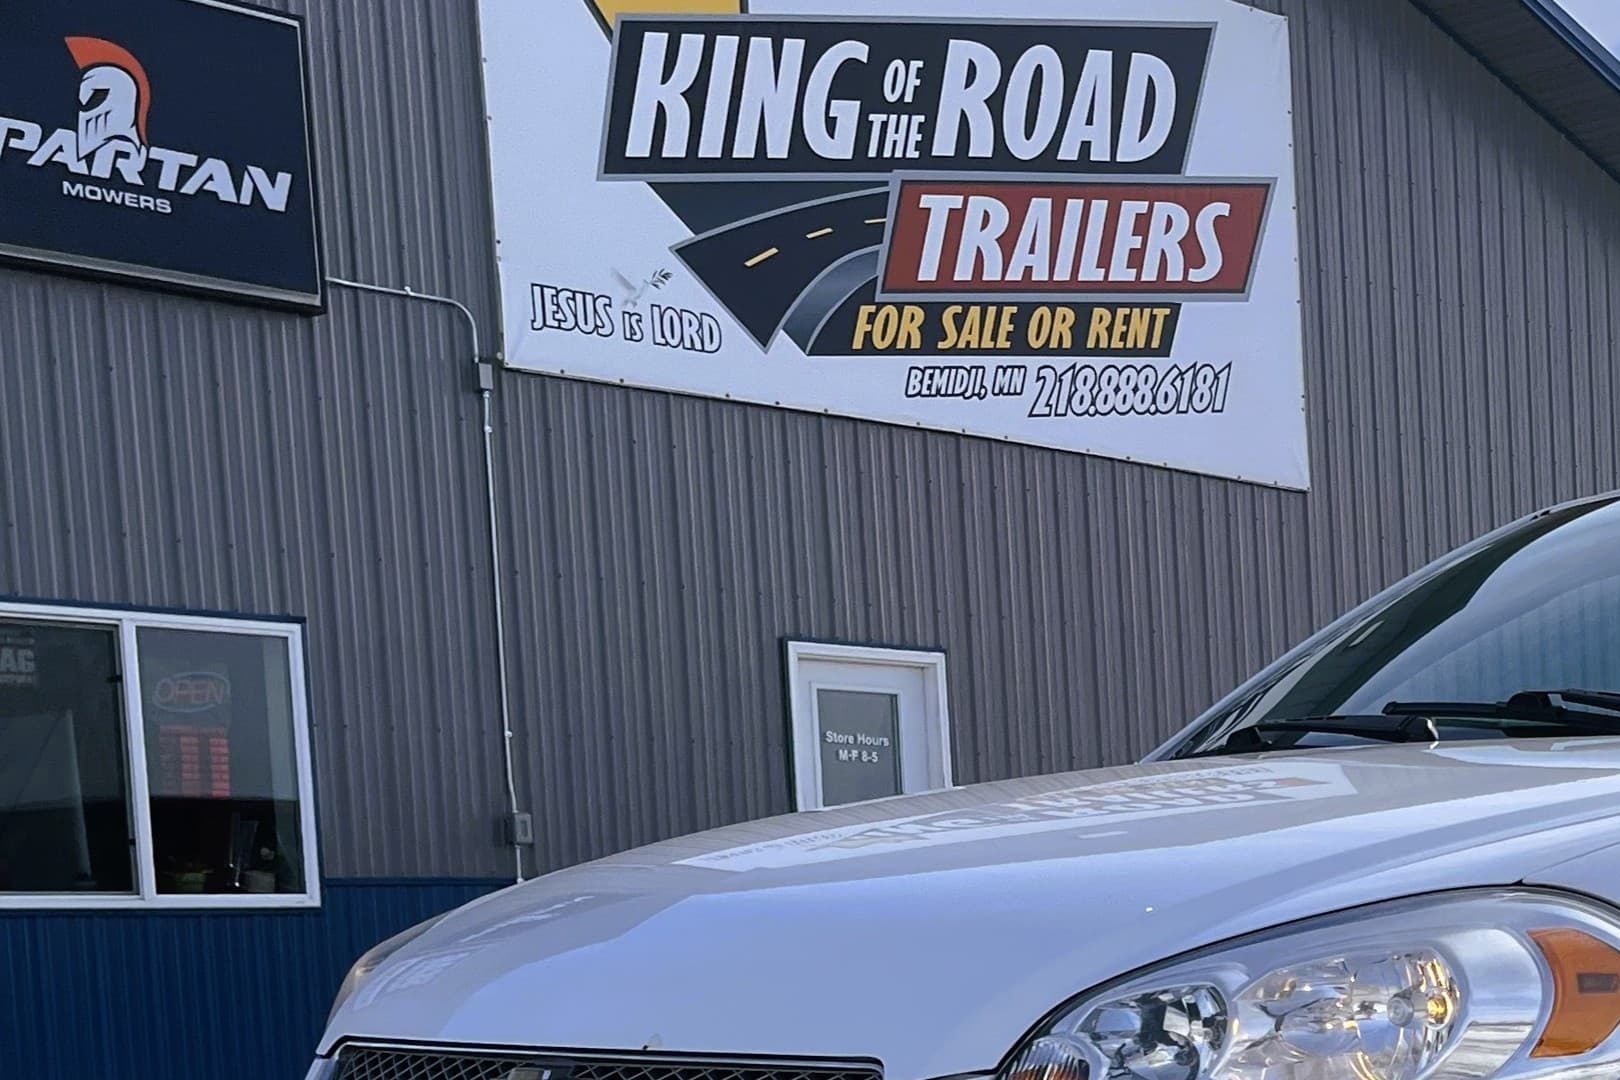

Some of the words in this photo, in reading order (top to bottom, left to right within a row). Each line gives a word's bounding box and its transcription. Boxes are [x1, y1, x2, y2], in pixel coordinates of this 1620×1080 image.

[625, 31, 869, 160] KING
[883, 59, 923, 102] OF
[931, 39, 1176, 162] ROAD
[868, 114, 925, 158] THE
[0, 116, 292, 212] PARTAN
[62, 181, 172, 213] MOWERS
[917, 194, 1230, 282] TRAILERS
[531, 283, 614, 337] JESUS
[651, 304, 722, 353] LORD
[851, 305, 925, 349] FOR
[937, 305, 1018, 349] SALE
[1027, 306, 1075, 349] OR
[1086, 307, 1171, 349] RENT
[905, 366, 987, 399] BEMIDJI,
[992, 366, 1027, 395] MN
[1028, 361, 1232, 418] 218.888.6181
[155, 678, 225, 704] OPEN
[826, 730, 854, 744] Store
[857, 733, 889, 746] Hours
[861, 750, 879, 763] 8-5
